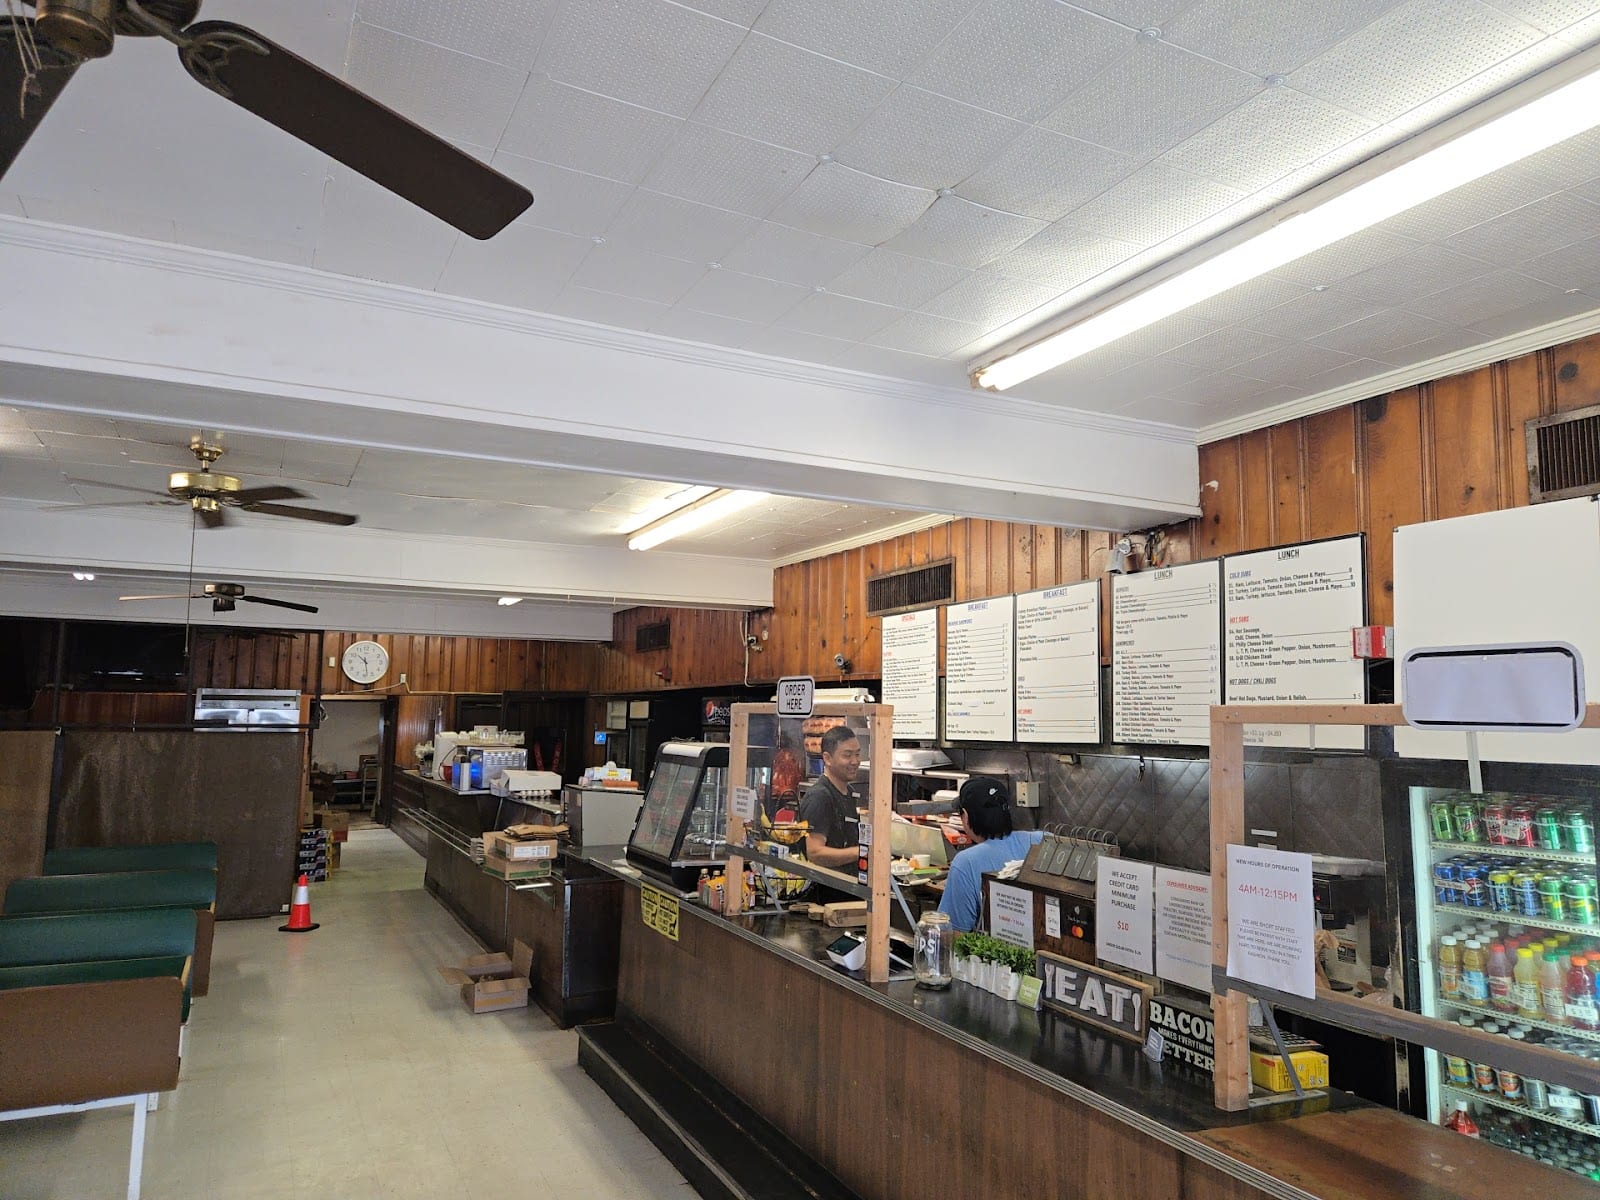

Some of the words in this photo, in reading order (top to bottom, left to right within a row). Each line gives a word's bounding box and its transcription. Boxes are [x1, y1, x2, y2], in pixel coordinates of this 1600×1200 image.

[1277, 549, 1300, 560] LUNCH
[1154, 570, 1173, 580] LUNCH
[785, 684, 805, 696] ORDER
[787, 698, 802, 710] HERE
[1272, 864, 1299, 873] OPERATION
[1120, 872, 1137, 881] ACCEPT
[1109, 880, 1124, 889] CREDIT
[1126, 883, 1139, 892] CARD
[1112, 890, 1136, 901] MINIMUM
[1238, 883, 1297, 903] 4AM-12:15PM
[1111, 900, 1136, 911] PURCHASE
[1117, 920, 1129, 932] $10
[1056, 967, 1132, 1023] EAT
